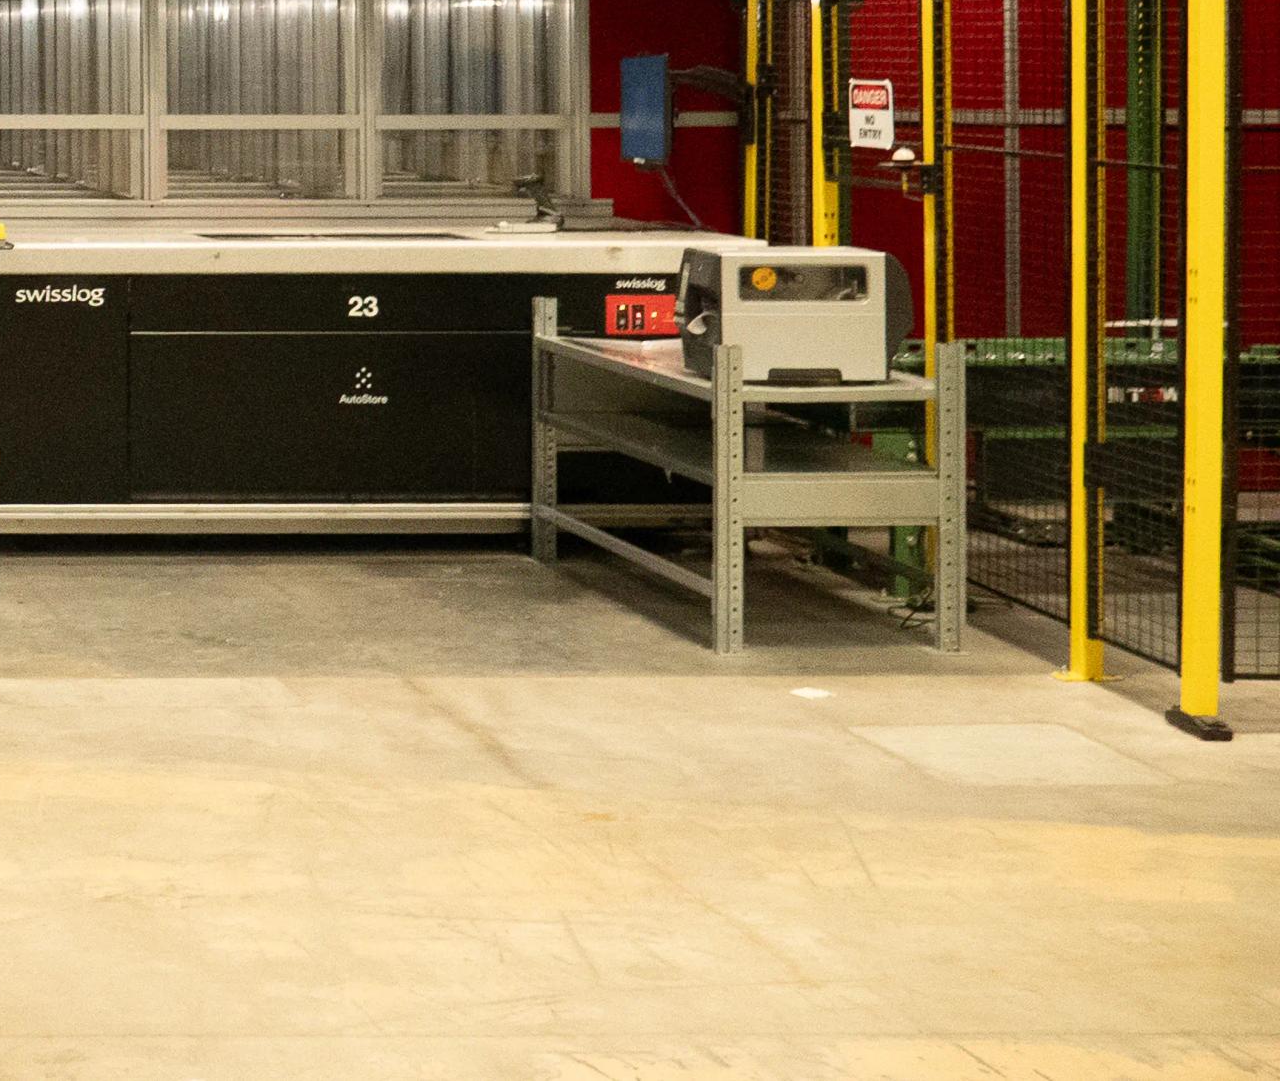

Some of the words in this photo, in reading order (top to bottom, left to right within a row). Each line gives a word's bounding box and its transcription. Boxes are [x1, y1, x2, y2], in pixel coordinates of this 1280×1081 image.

[853, 88, 888, 105] DANGER
[865, 115, 875, 126] NO
[859, 128, 882, 140] ENTRY
[615, 278, 666, 292] swisslog
[15, 284, 106, 307] swisslog
[348, 296, 379, 318] 23
[339, 393, 389, 405] AutoStore
